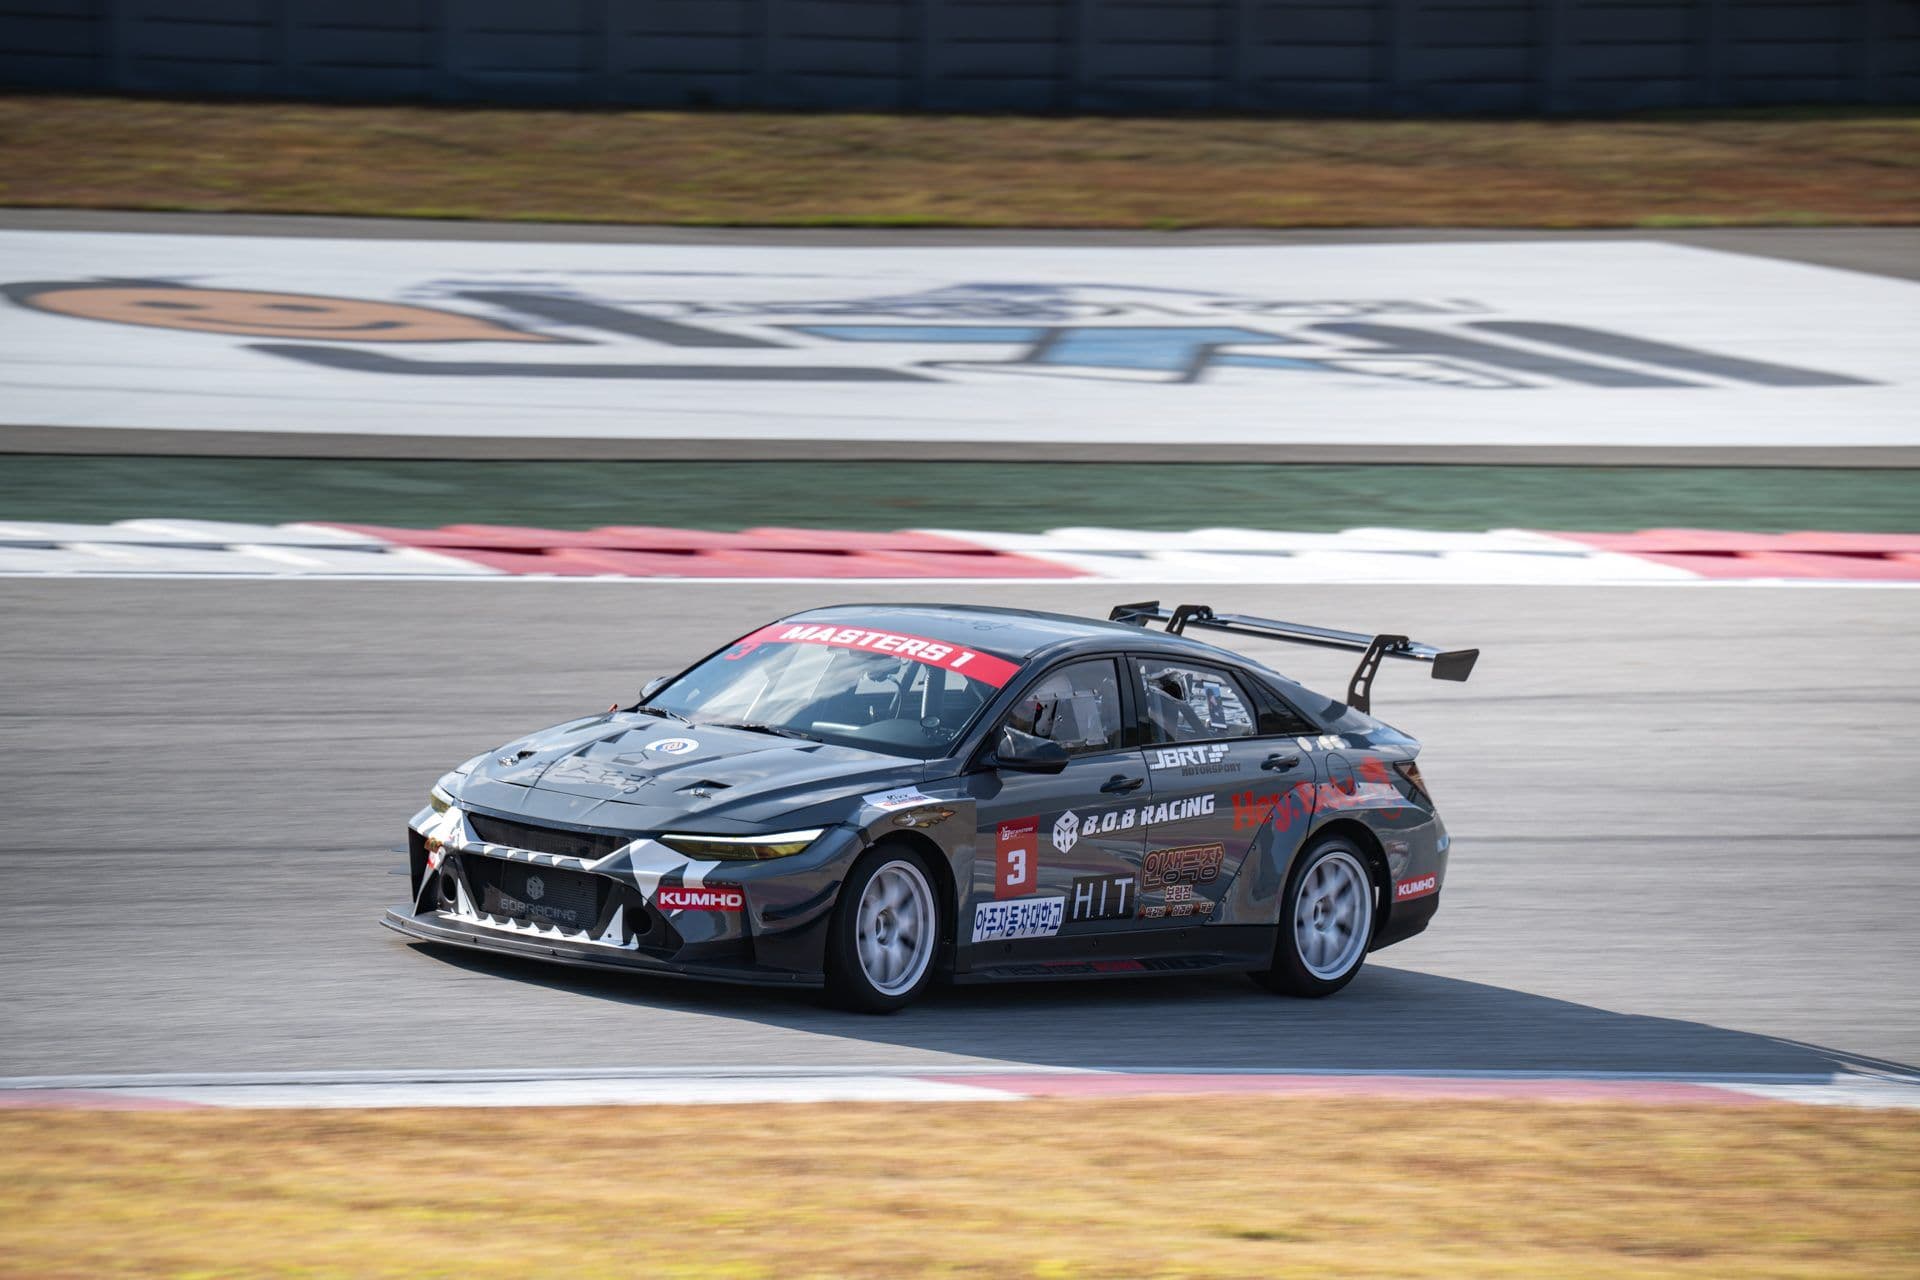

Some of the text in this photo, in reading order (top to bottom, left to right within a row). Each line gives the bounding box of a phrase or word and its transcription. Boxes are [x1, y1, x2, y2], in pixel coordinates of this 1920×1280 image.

[779, 625, 948, 662] MASTERS
[951, 650, 976, 668] 1
[1150, 745, 1208, 770] JBRT
[1081, 794, 1215, 836] B.O.B RACING
[1006, 849, 1027, 886] 3
[1142, 844, 1223, 889] 인생극장
[660, 892, 743, 907] KUMHO
[1398, 877, 1436, 897] KUMHO
[975, 902, 1062, 940] 아주자동차대학교
